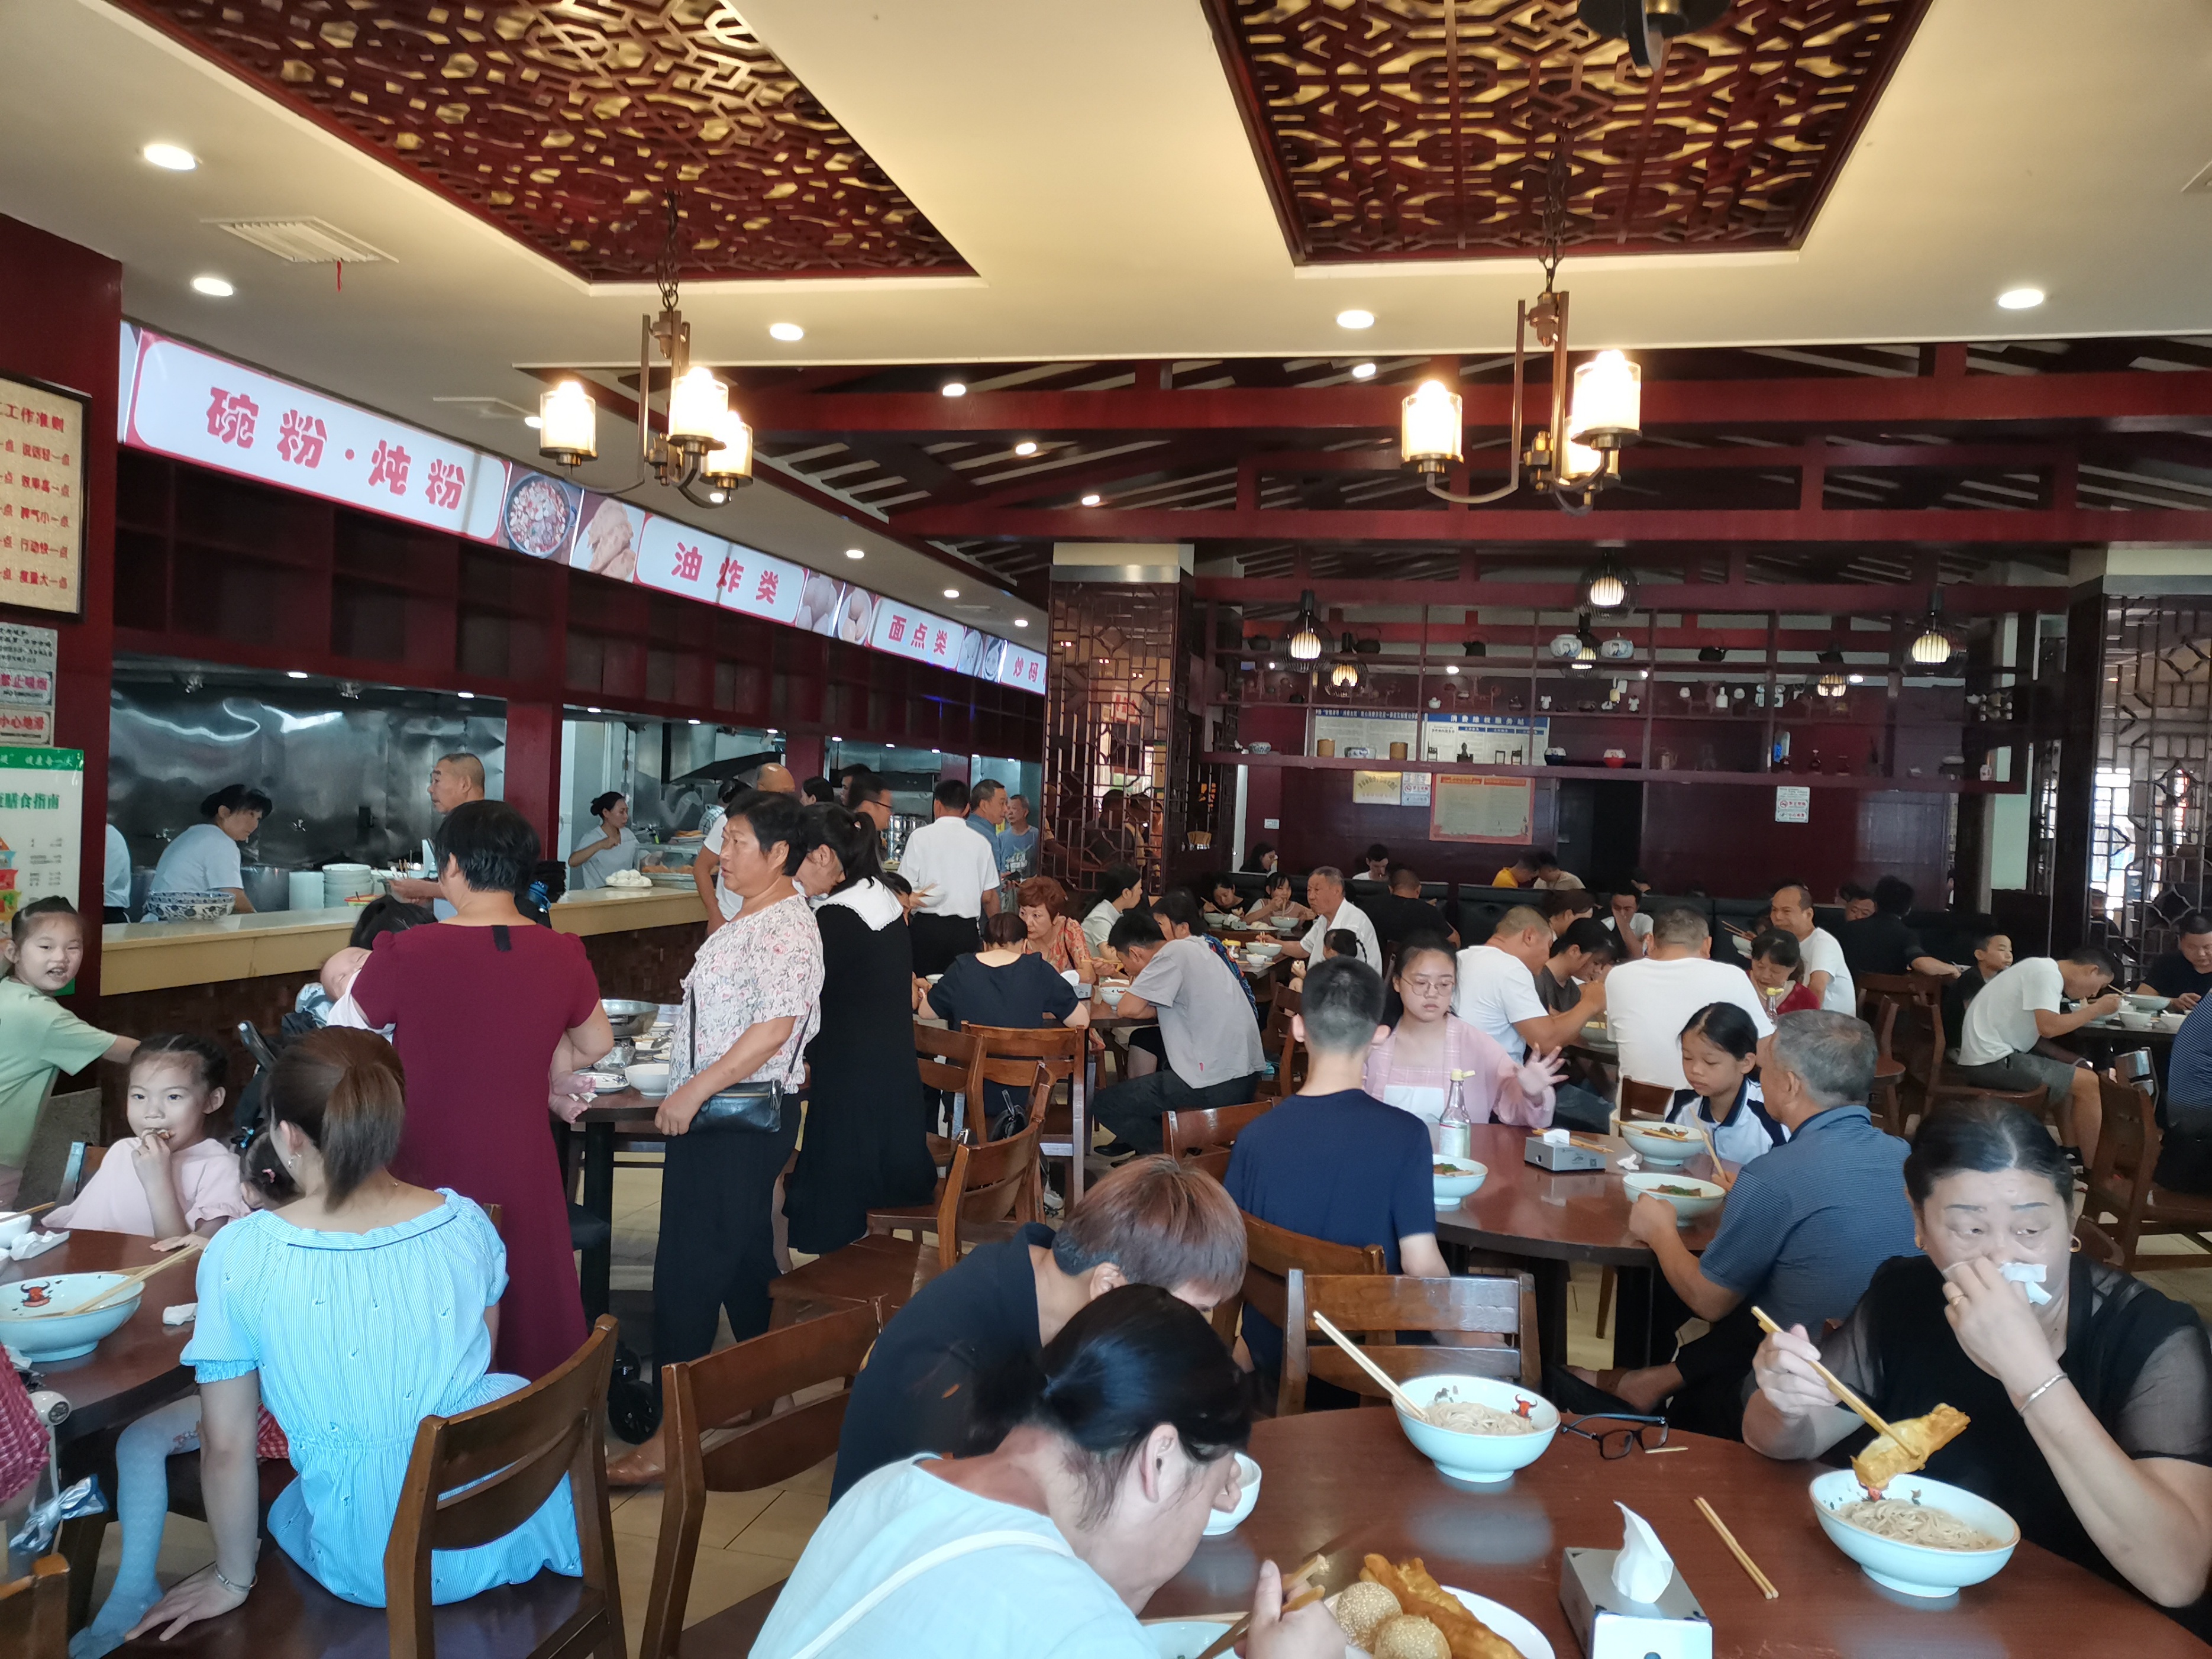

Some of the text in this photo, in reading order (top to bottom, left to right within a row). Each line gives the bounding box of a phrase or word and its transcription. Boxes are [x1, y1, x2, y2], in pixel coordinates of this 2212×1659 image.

[0, 402, 64, 432] 工作准则
[206, 386, 466, 510] 碗粉·炖粉
[671, 541, 780, 605] 油炸类
[888, 614, 948, 656] 面点类
